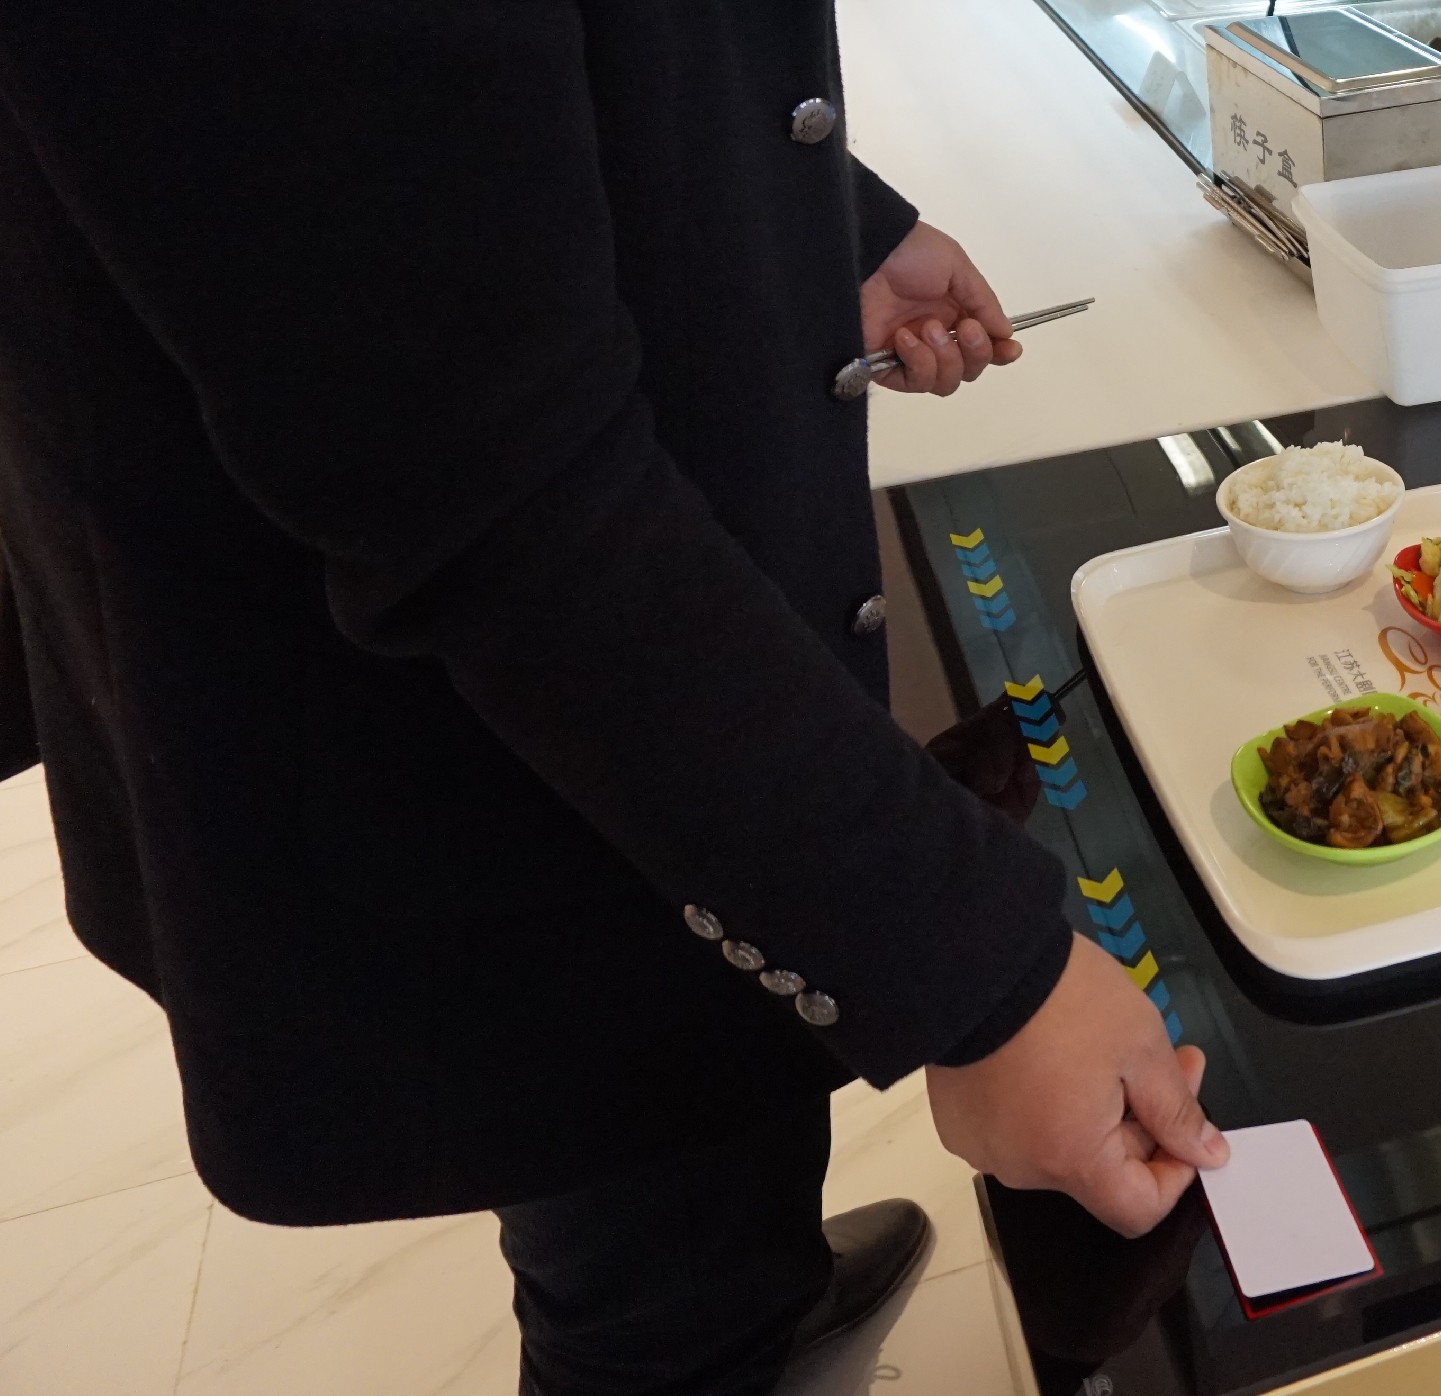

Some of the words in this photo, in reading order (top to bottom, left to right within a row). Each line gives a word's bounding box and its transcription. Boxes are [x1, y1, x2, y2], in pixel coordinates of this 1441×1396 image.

[1230, 113, 1298, 189] 筷子盒
[1334, 649, 1378, 695] 江苏大剧
